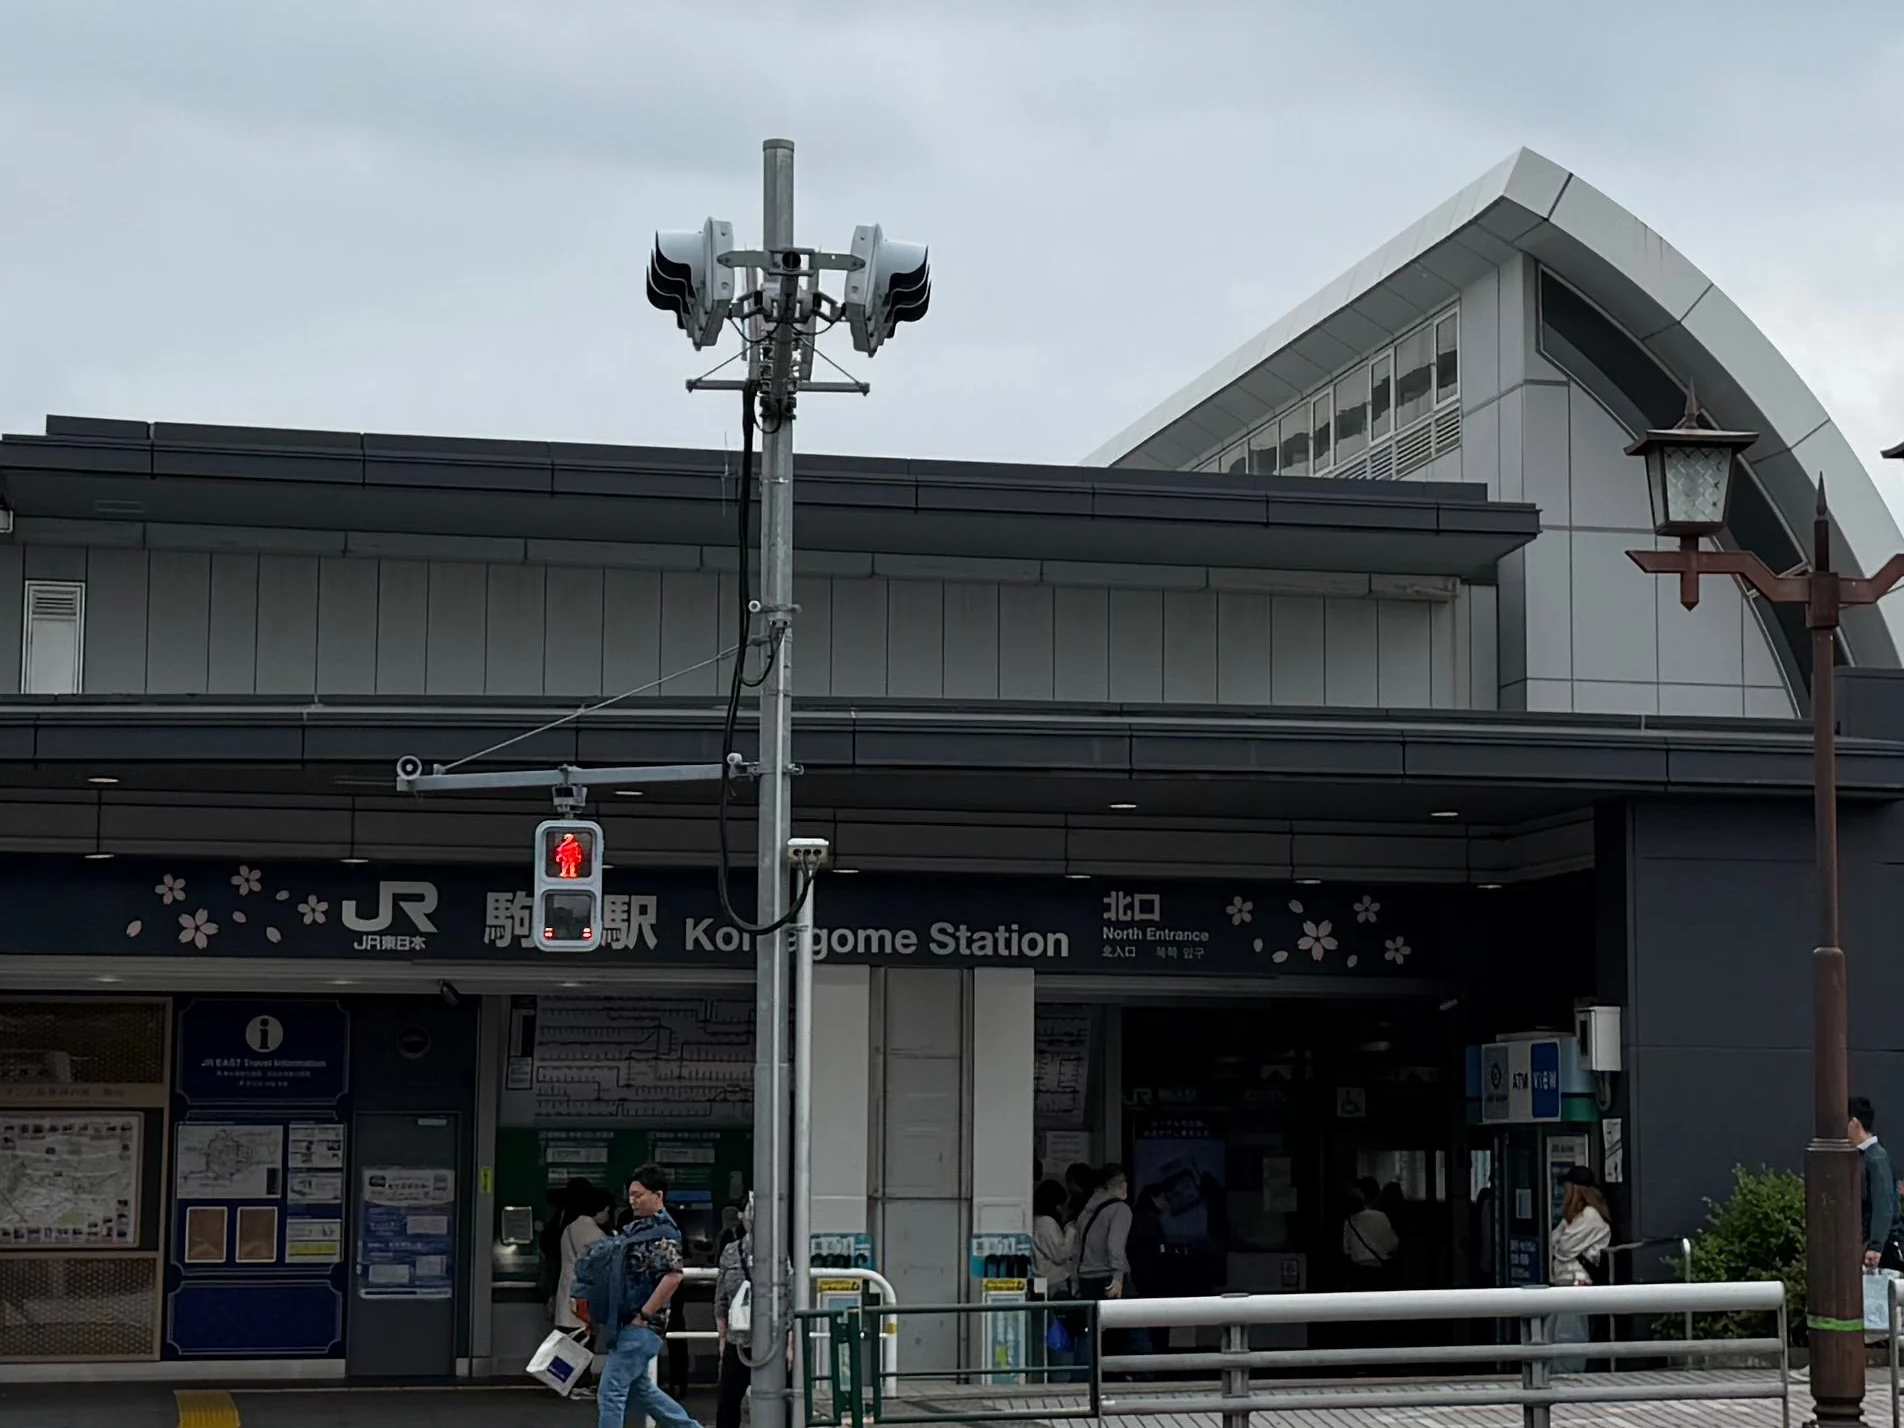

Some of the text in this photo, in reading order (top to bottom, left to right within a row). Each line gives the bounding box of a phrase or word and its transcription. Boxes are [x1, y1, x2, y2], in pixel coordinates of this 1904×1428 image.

[342, 881, 439, 933] JR
[1103, 891, 1161, 922] 北口
[484, 891, 659, 950] 駒駅
[354, 935, 426, 951] JR東日本
[929, 921, 1069, 957] Station
[1103, 926, 1209, 942] North Entrance
[215, 1058, 241, 1067] EAST
[1512, 1072, 1529, 1090] ATM
